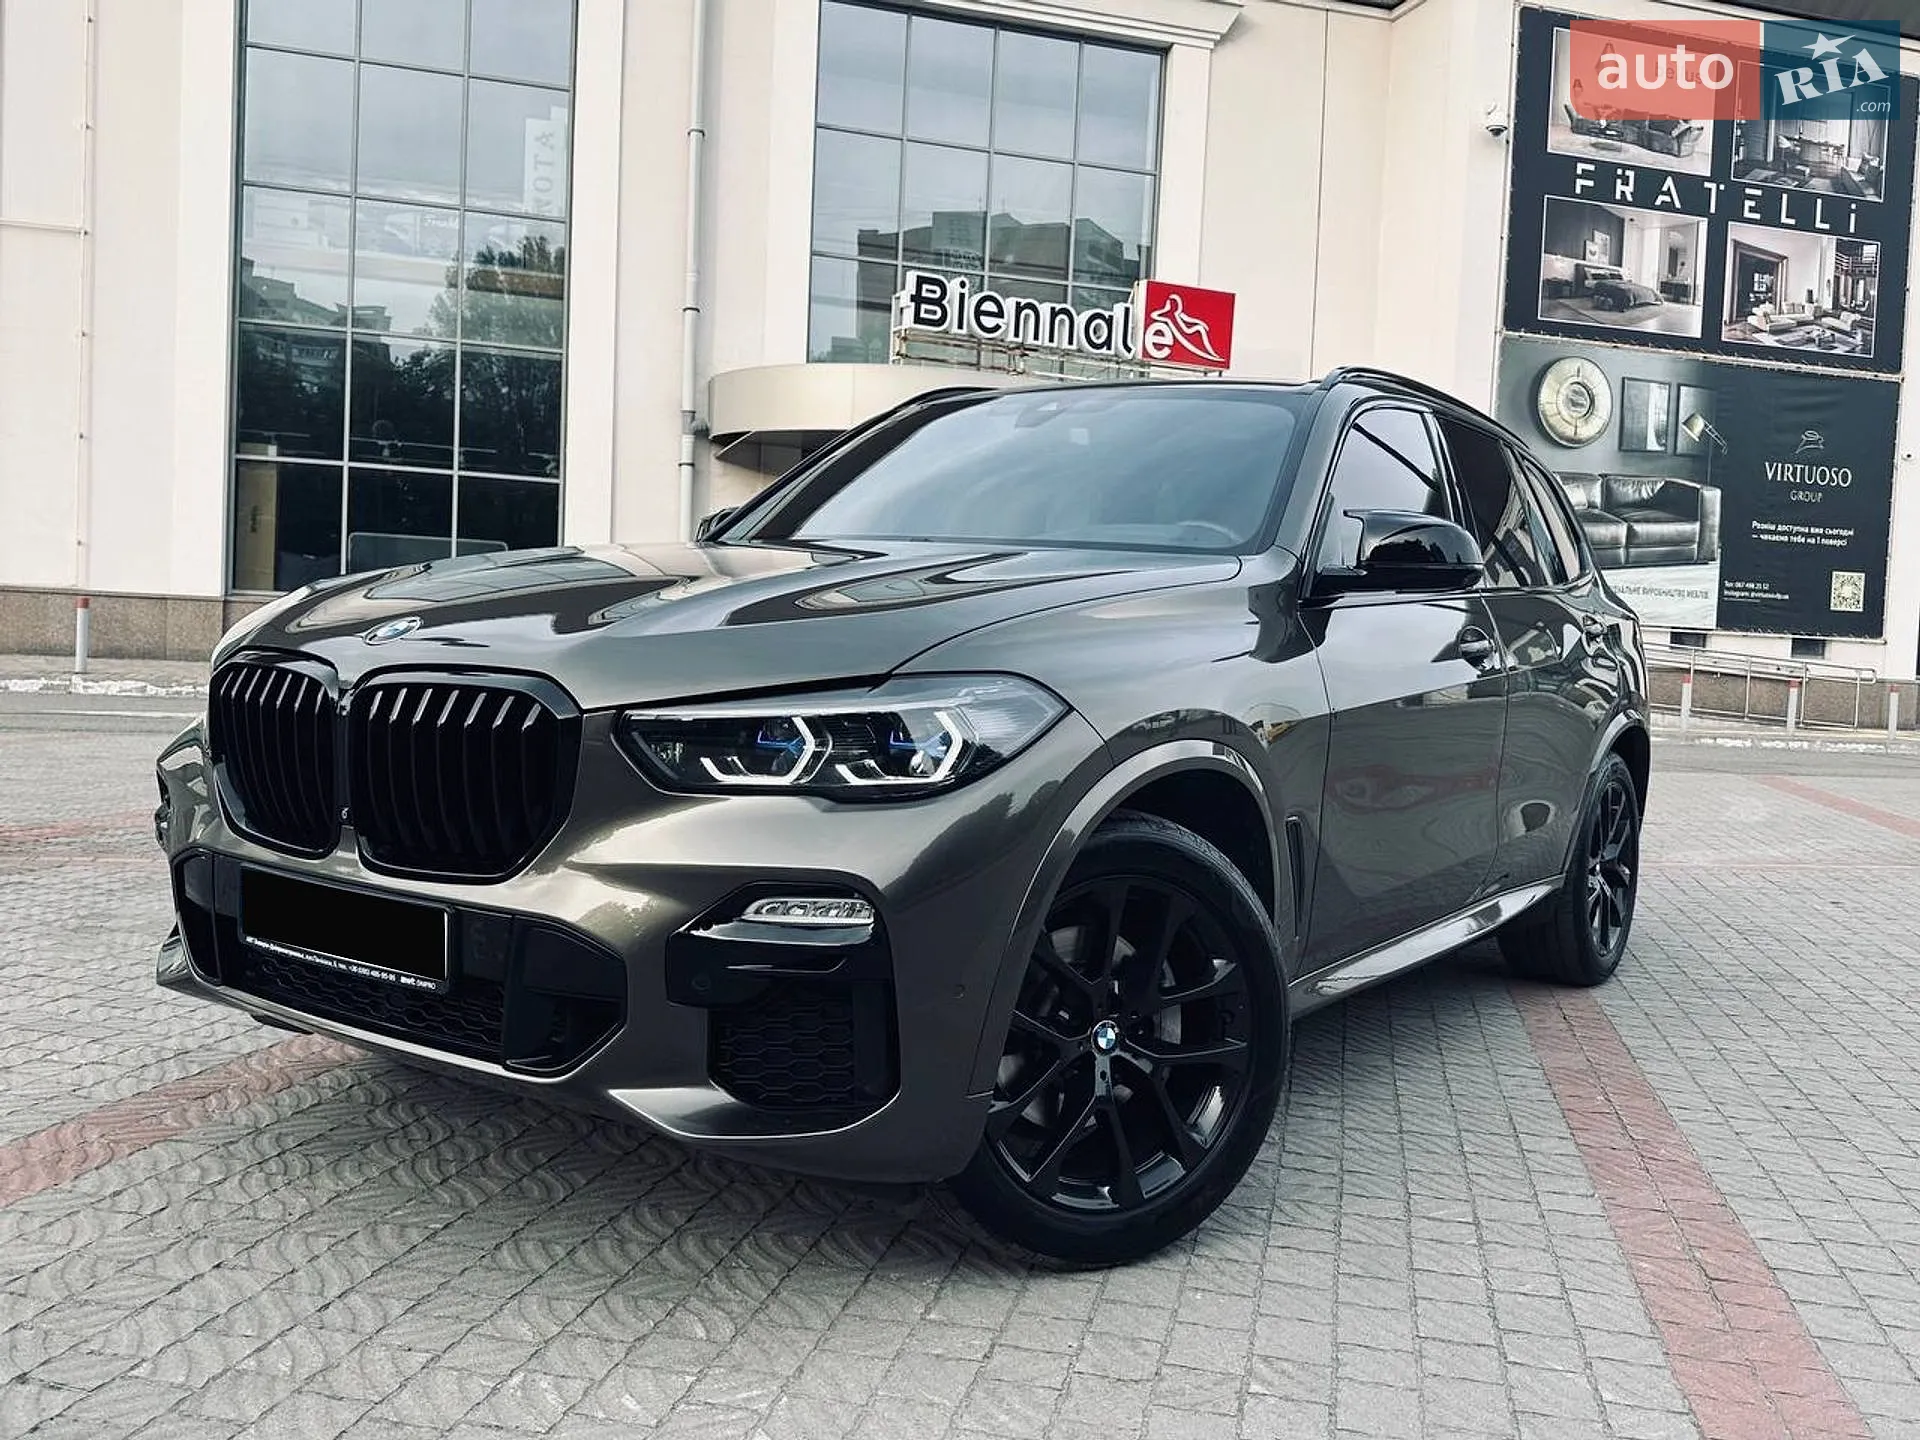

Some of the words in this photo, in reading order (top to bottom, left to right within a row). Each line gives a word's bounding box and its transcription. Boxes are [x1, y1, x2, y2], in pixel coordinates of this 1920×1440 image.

[910, 272, 1174, 359] Biennale
[1764, 461, 1852, 487] VIRTUOSO
[1789, 490, 1823, 503] GROUP
